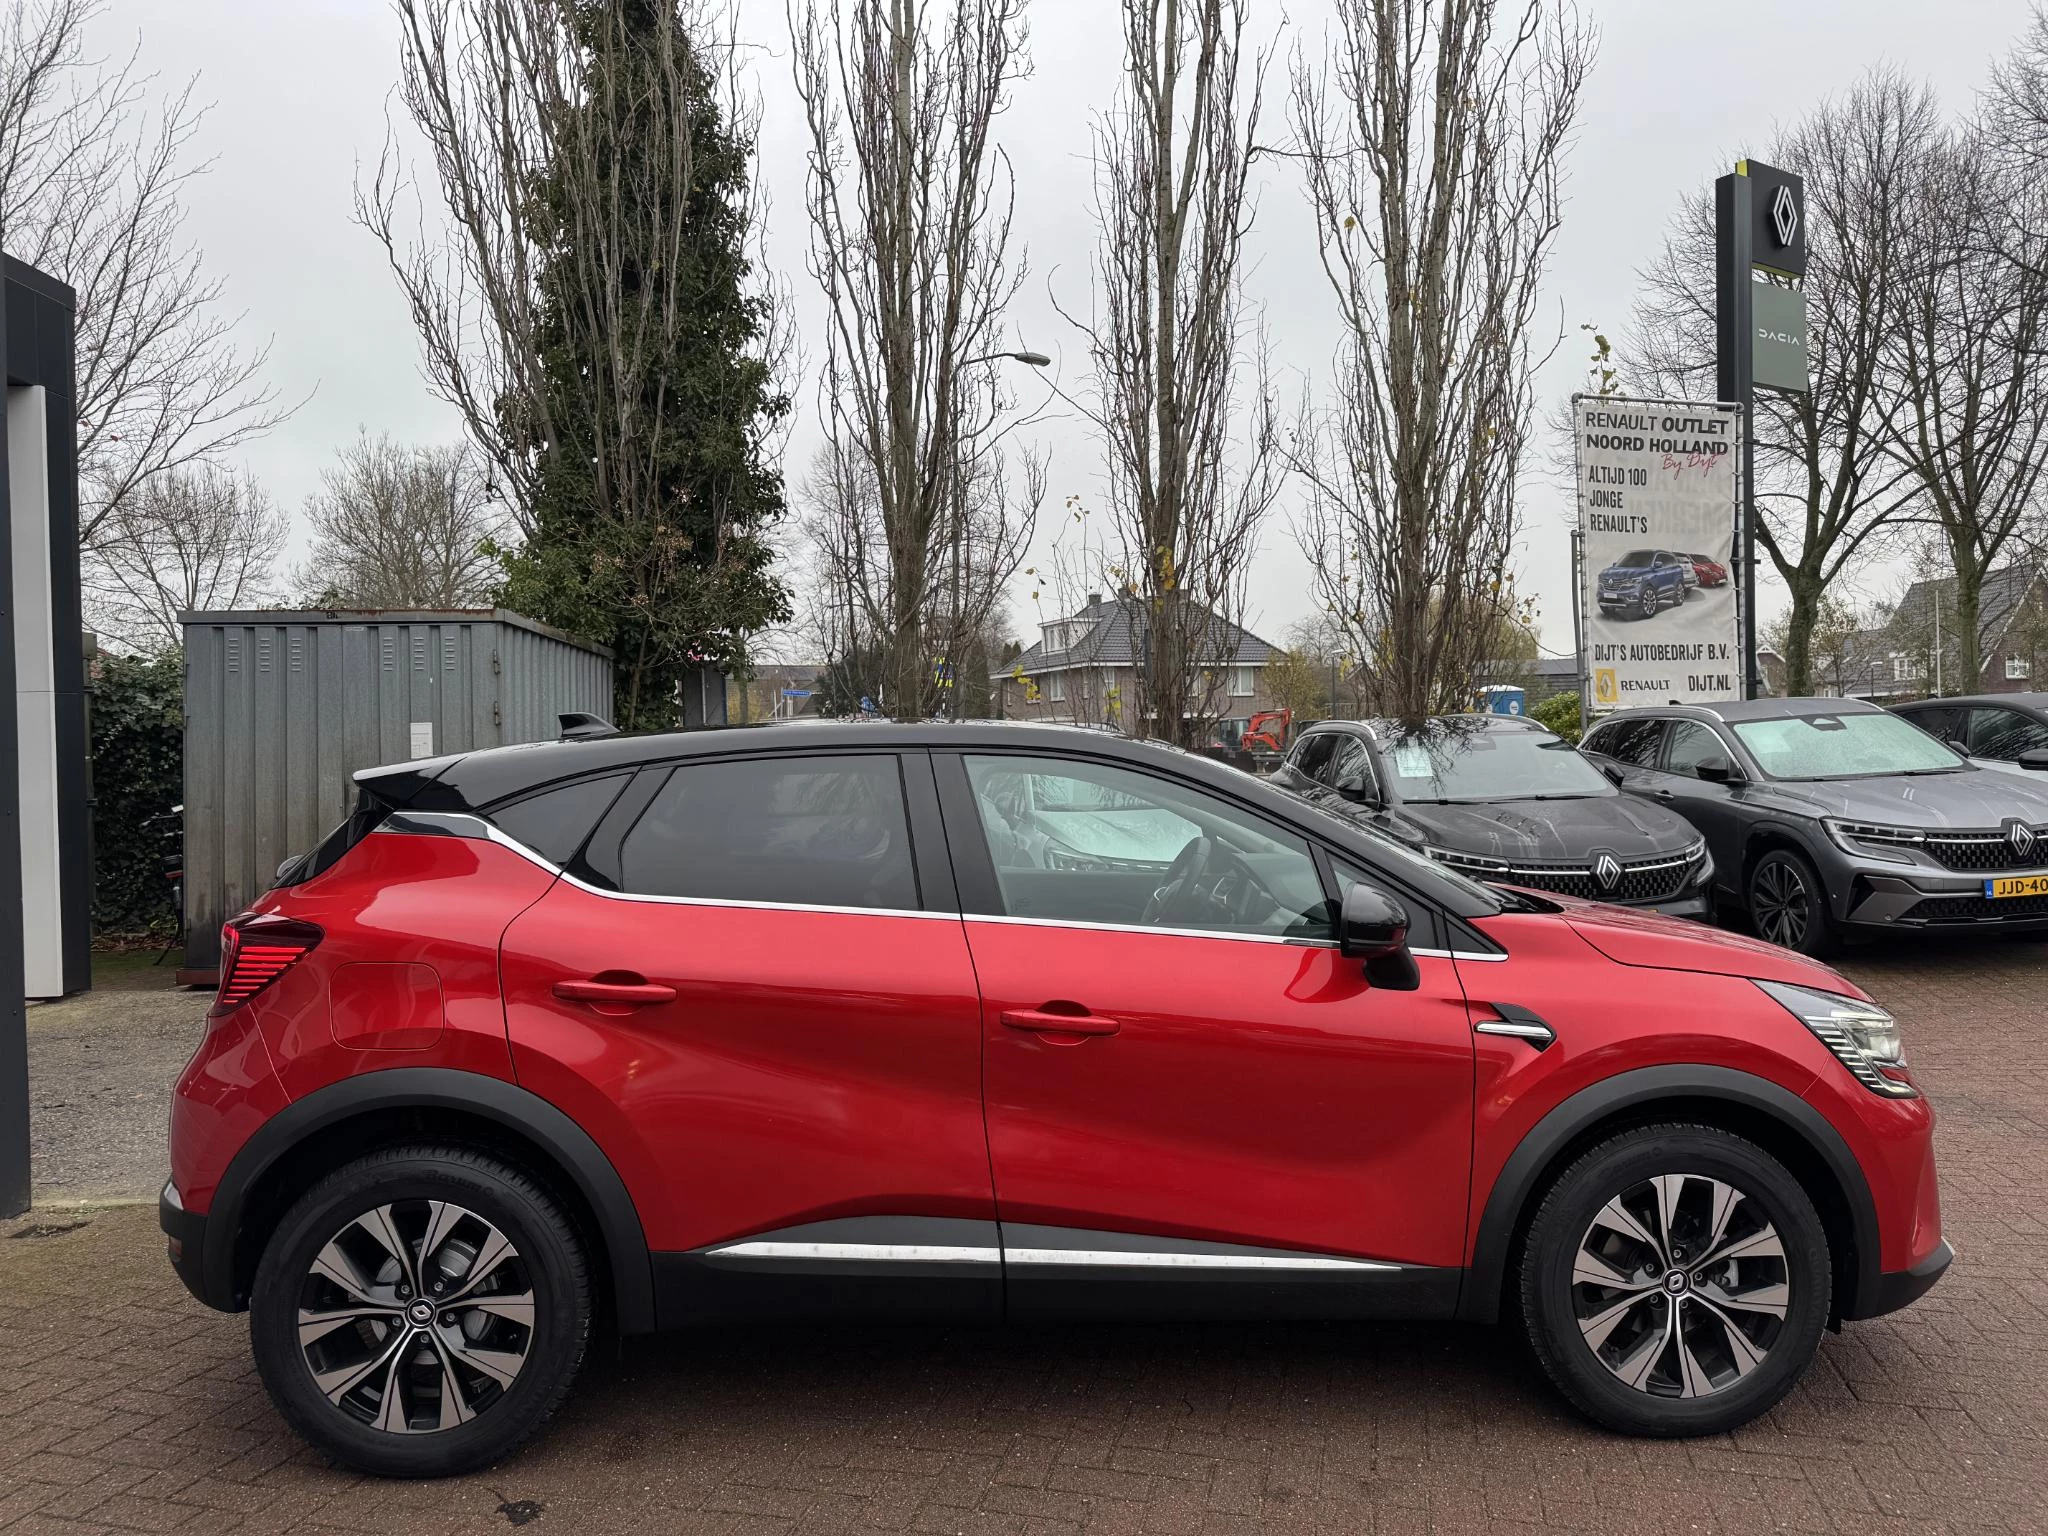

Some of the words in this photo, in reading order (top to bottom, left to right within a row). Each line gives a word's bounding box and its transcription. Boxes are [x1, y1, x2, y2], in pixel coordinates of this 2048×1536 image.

[1758, 328, 1800, 346] DACIA
[1585, 412, 1658, 431] RENAULT
[1661, 417, 1729, 434] OUTLET
[1586, 434, 1645, 452] NOORD
[1649, 438, 1729, 455] HOLLAND
[1588, 465, 1625, 485] ALTIJD
[1627, 468, 1647, 486] 100
[1661, 453, 1684, 481] By
[1589, 489, 1624, 508] JONGE
[1590, 513, 1648, 533] RENAULT'S
[1594, 643, 1627, 661] DIJT'S
[1630, 643, 1704, 661] AUTOBEDRIJF
[1708, 643, 1730, 660] B.V.
[1620, 679, 1671, 691] RENAULT
[1687, 674, 1731, 692] DIJT.NL
